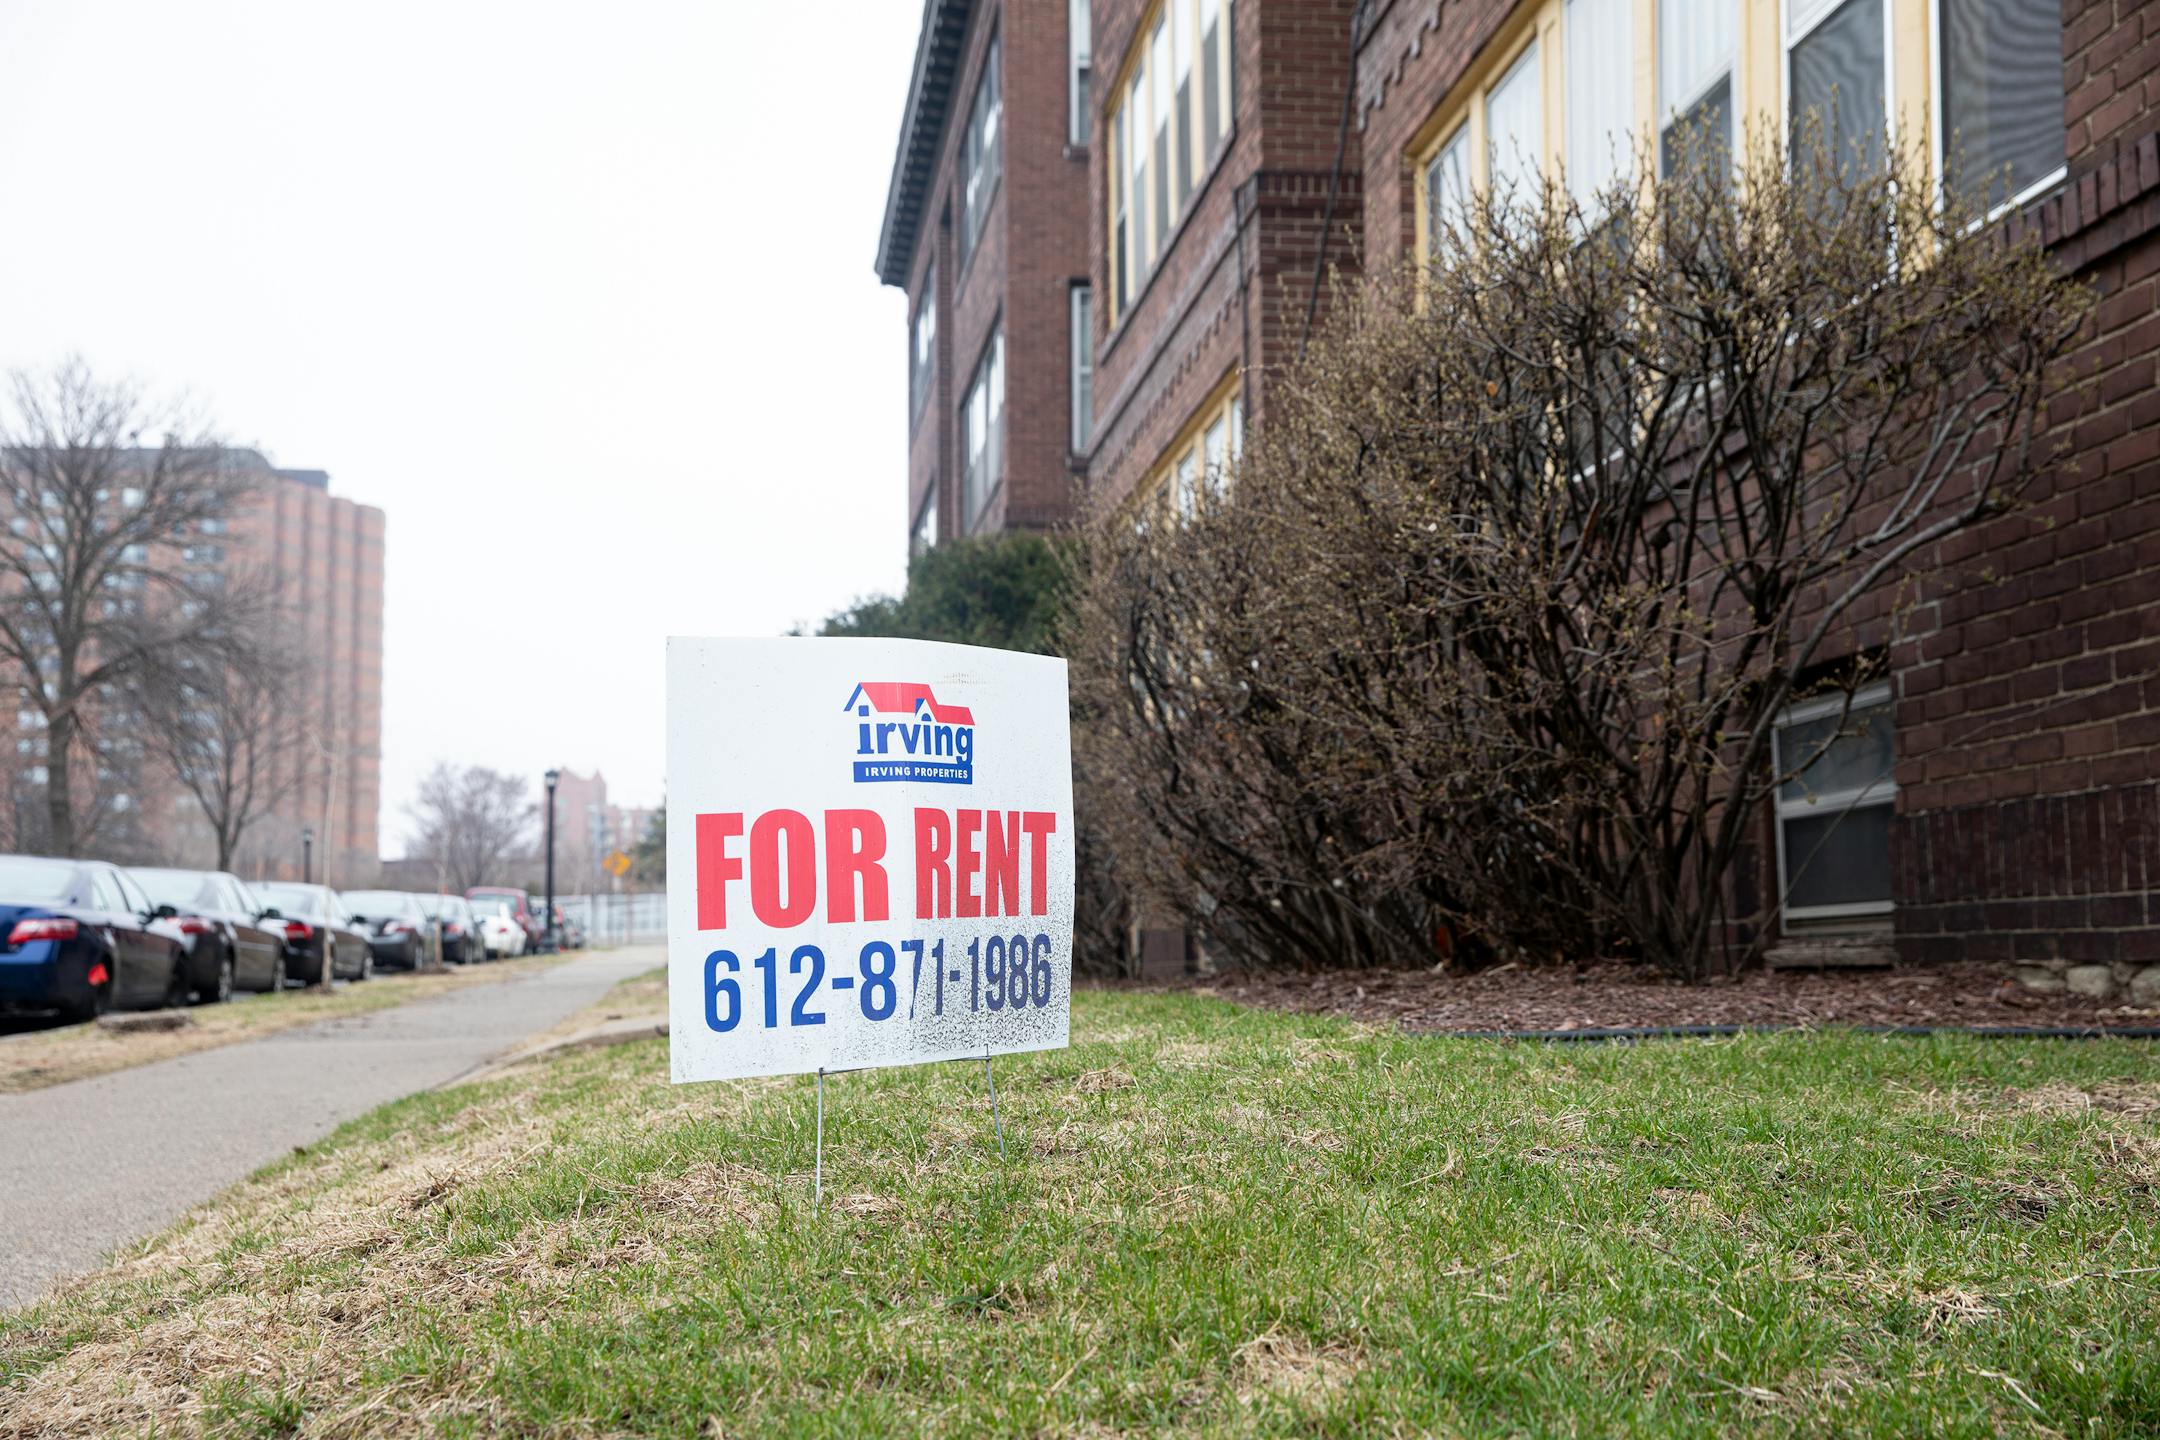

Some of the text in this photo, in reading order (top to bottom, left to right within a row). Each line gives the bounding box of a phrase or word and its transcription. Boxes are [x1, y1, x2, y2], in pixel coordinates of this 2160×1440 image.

[857, 705, 973, 764] irving
[865, 767, 968, 779] IRVING PROPERTIES
[695, 807, 1056, 930] FOR RENT
[703, 934, 1052, 1033] 612-871-1986
